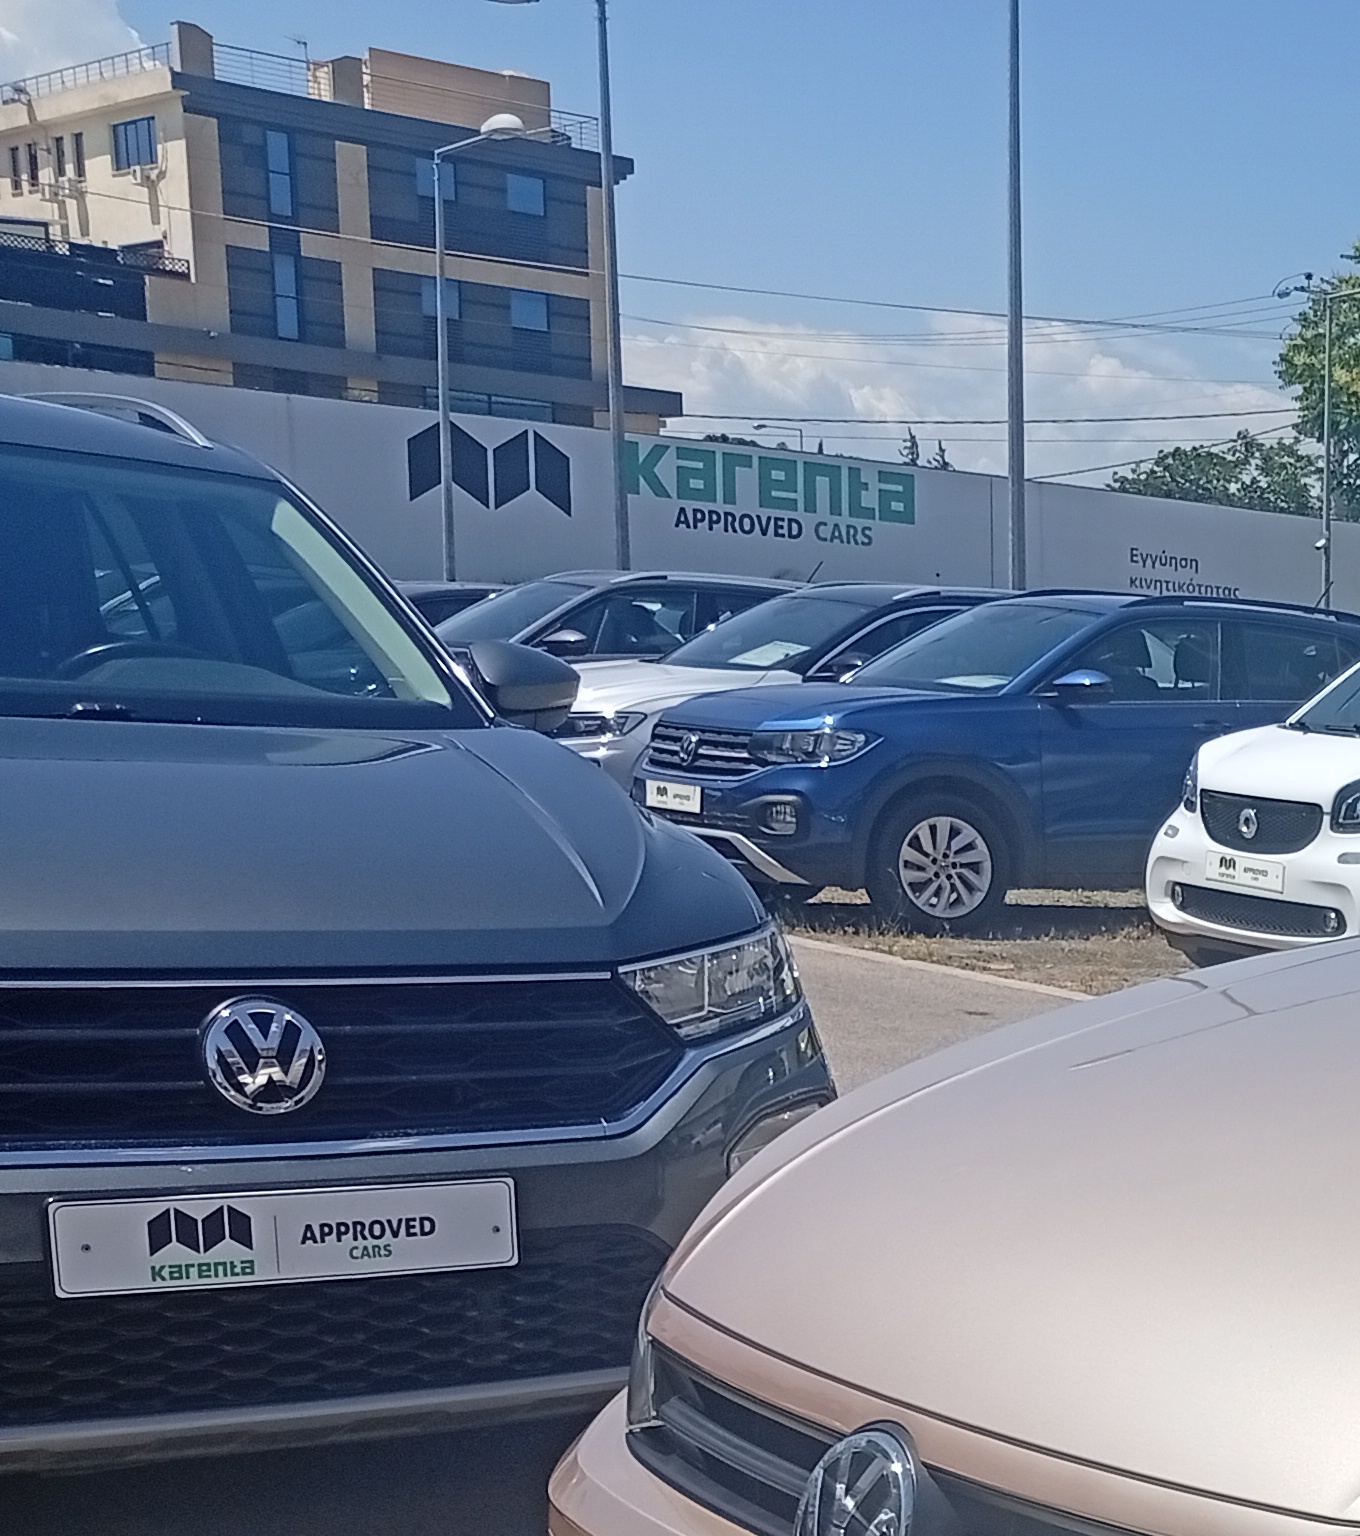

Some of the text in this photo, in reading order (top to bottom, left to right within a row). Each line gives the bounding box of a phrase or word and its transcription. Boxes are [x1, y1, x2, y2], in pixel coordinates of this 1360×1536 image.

[674, 507, 873, 546] APPROVED CARS
[1130, 547, 1198, 574] Εγγύηση
[1129, 577, 1240, 599] κινητικότητας
[300, 1217, 436, 1245] APPROVED
[349, 1244, 393, 1260] CARS
